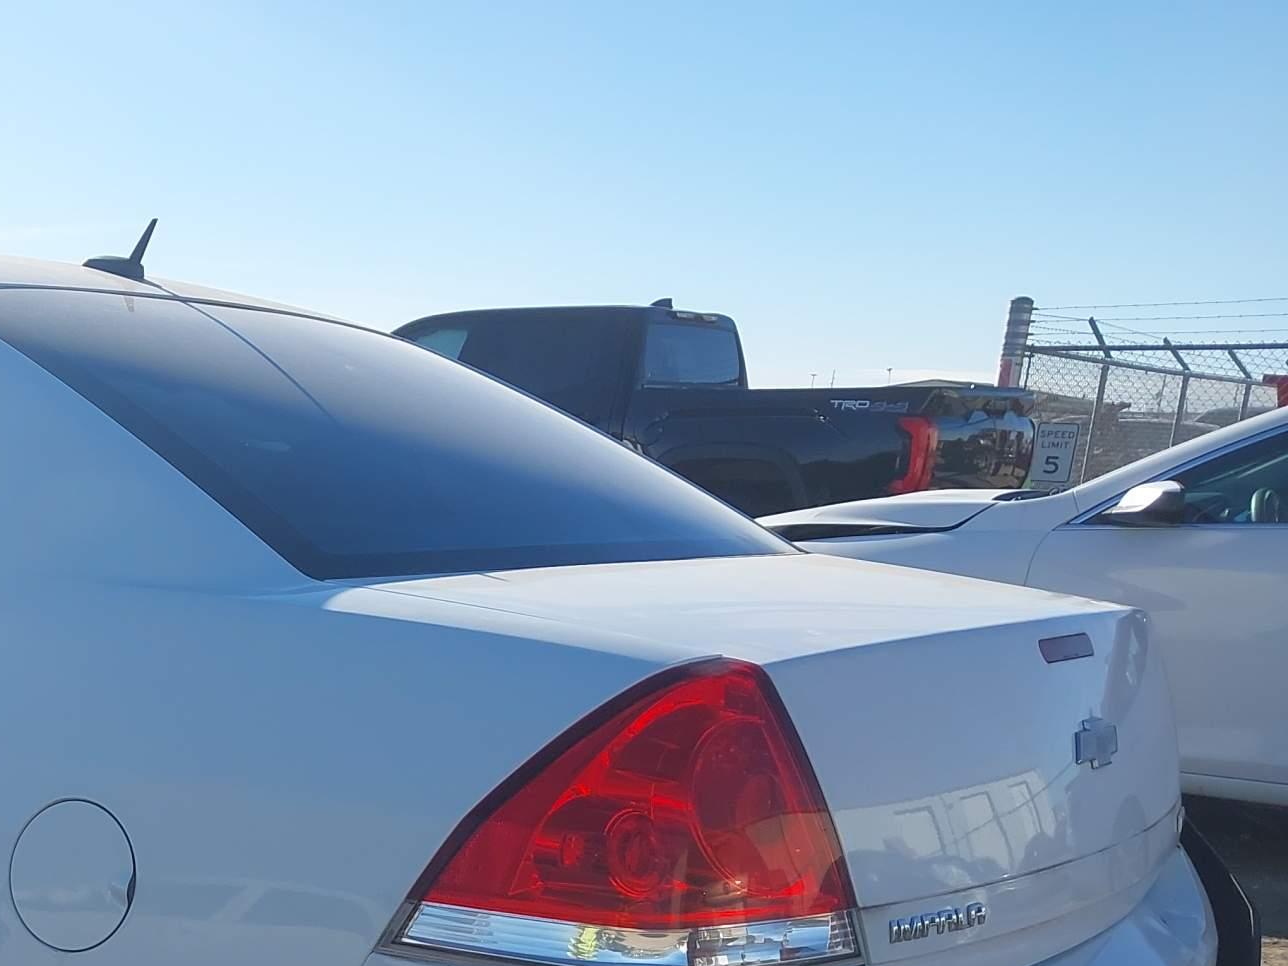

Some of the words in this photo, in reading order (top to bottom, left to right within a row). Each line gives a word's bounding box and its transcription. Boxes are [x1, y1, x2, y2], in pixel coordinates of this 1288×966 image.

[830, 400, 869, 410] TRD
[1039, 430, 1075, 439] SPEED
[1041, 441, 1070, 449] LIMIT
[1043, 456, 1059, 474] 5
[889, 902, 986, 944] IMPALA
